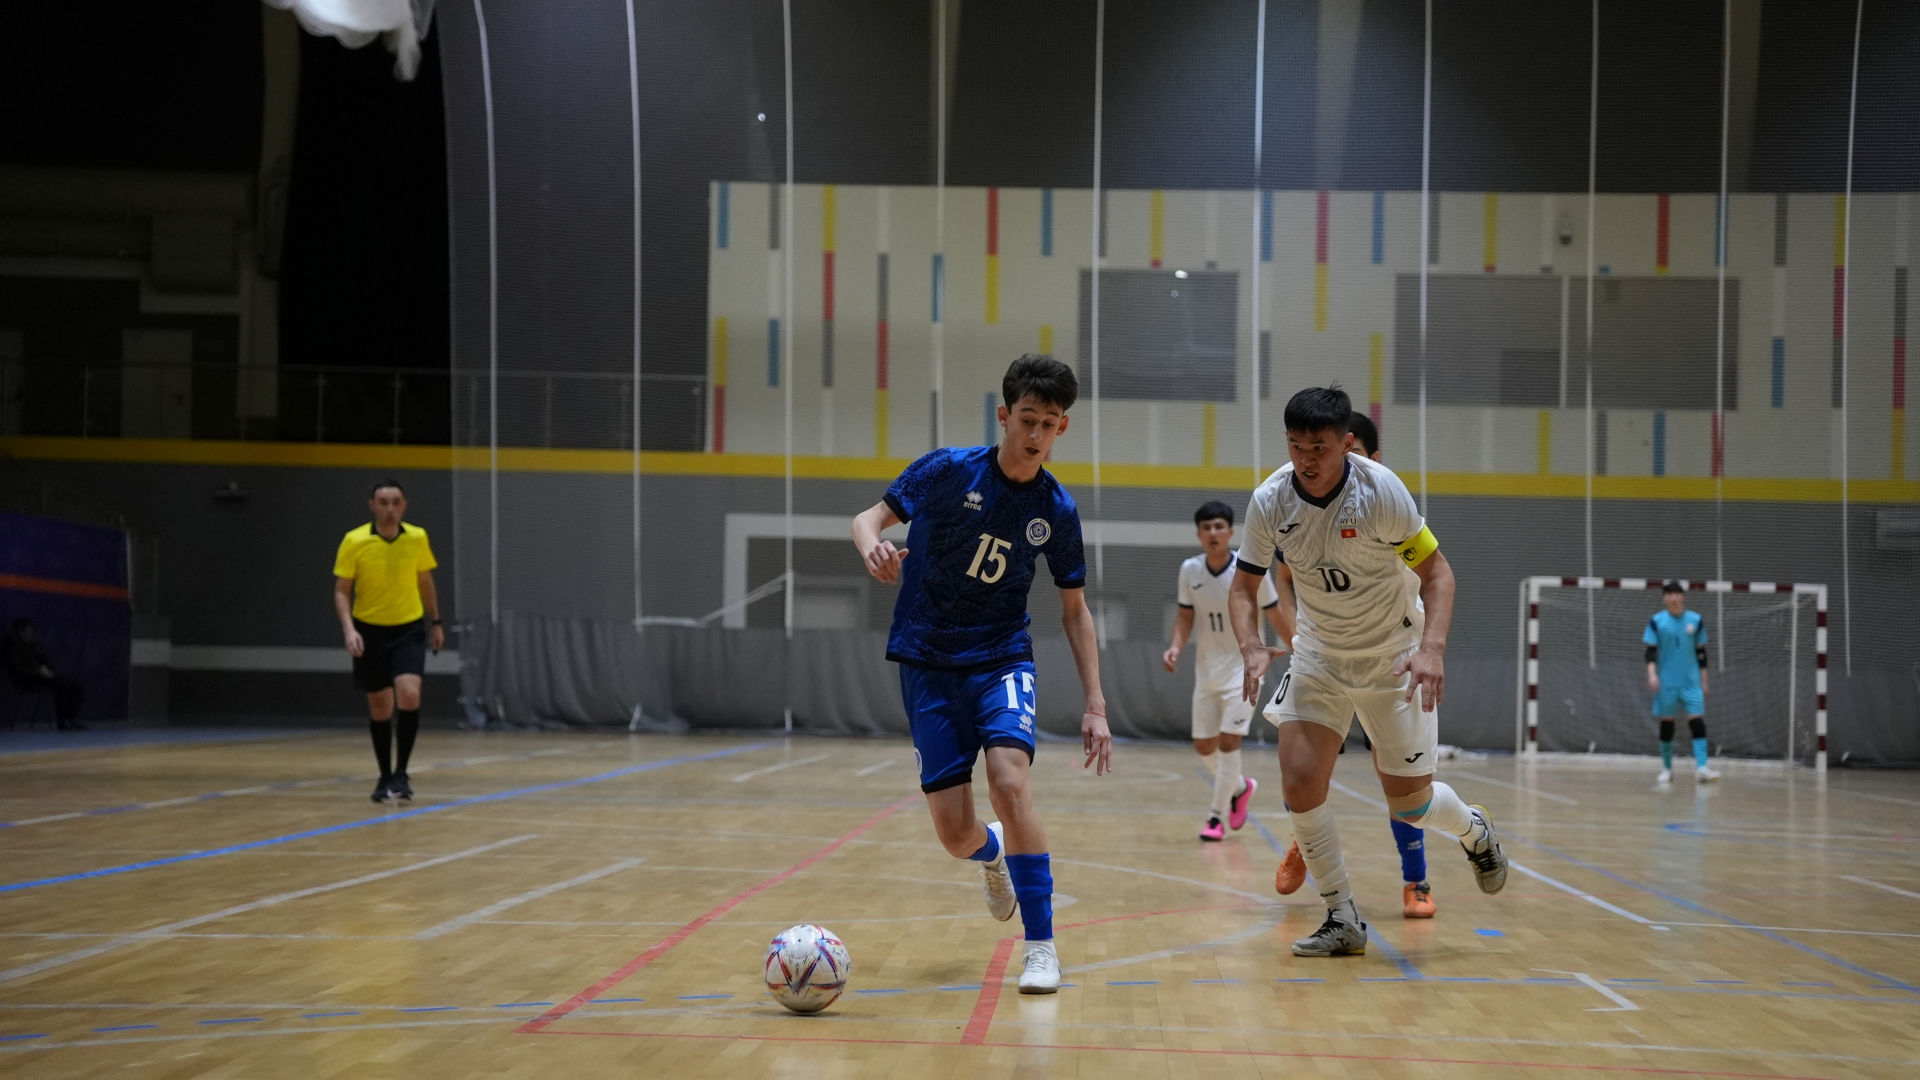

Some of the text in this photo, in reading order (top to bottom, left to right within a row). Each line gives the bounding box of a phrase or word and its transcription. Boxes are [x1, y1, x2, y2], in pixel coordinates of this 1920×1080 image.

[965, 533, 1012, 584] 15
[1316, 567, 1351, 593] 10
[1208, 612, 1224, 632] 11
[1001, 672, 1036, 716] 15
